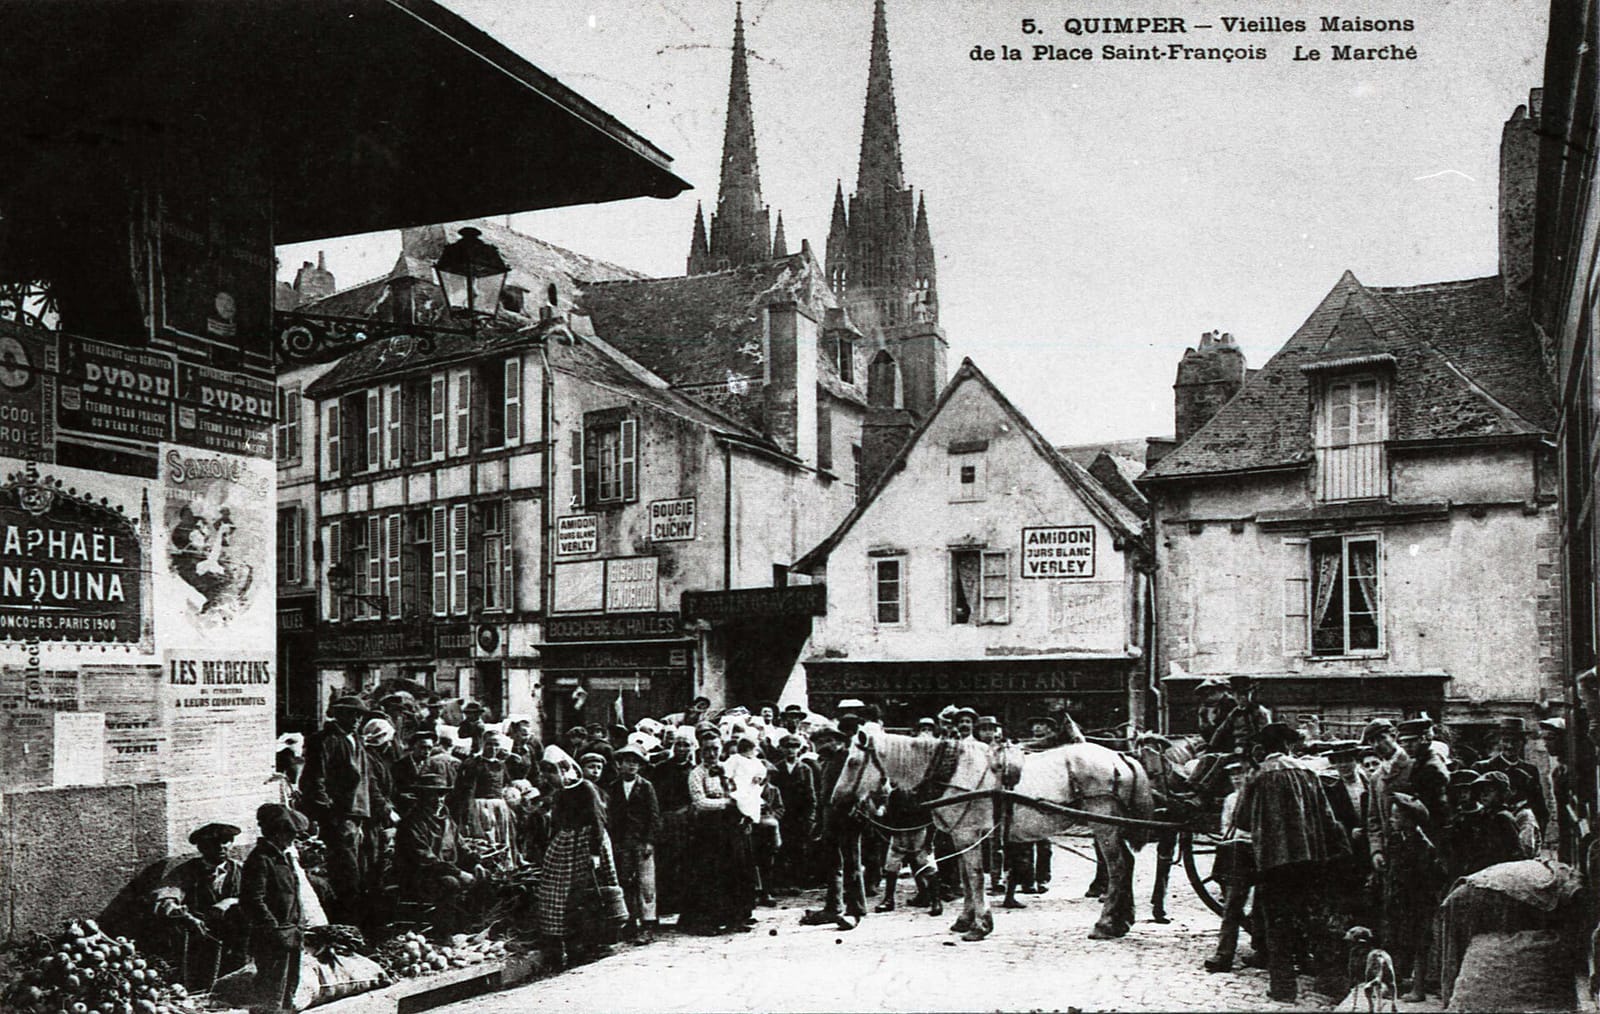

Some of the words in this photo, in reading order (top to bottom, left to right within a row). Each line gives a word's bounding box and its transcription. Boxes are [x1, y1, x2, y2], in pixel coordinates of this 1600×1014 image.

[653, 501, 693, 518] BOUGIE
[561, 517, 595, 530] AMIDON
[561, 540, 594, 553] VERLEY
[1056, 547, 1090, 557] BLANC
[1028, 560, 1087, 574] VERLEY
[59, 616, 90, 630] PARIS
[92, 618, 117, 631] 1900
[170, 659, 197, 685] LES
[184, 697, 210, 708] LEURS
